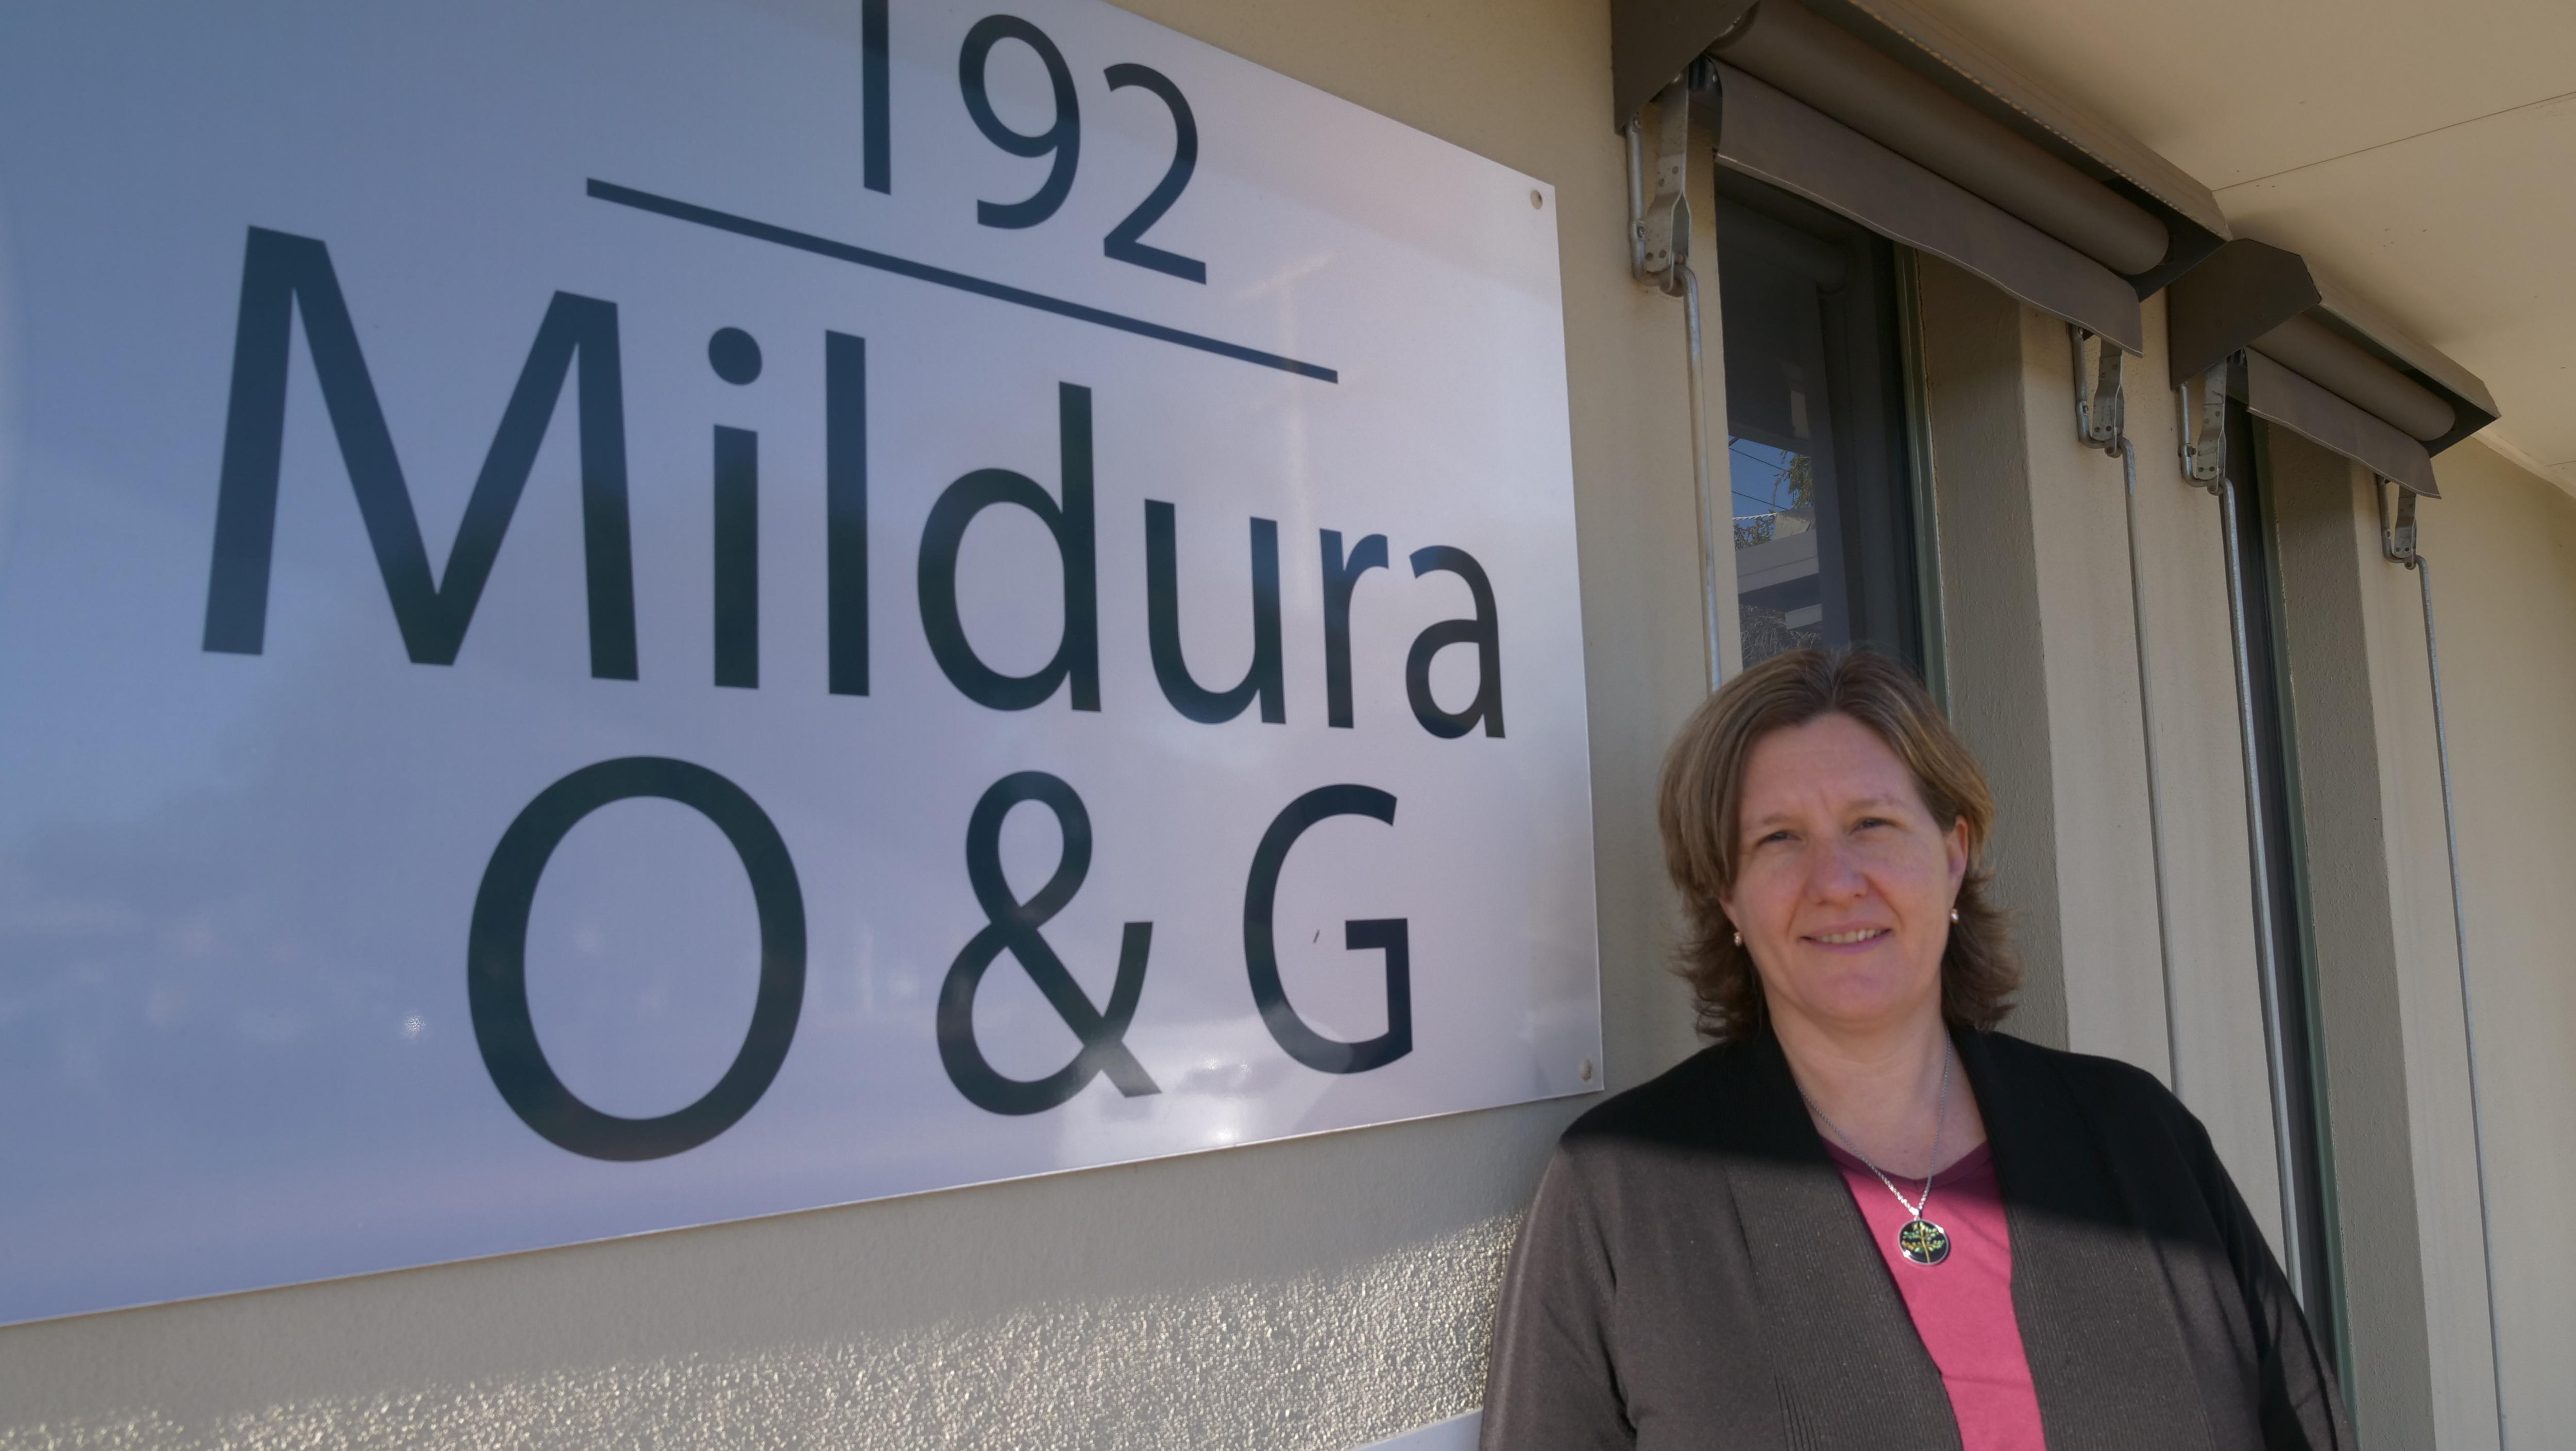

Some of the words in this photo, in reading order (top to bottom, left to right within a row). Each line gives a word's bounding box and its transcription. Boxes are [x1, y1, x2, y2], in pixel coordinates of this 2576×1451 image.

[861, 0, 1207, 285] 192
[201, 223, 1506, 741] Mildura
[466, 755, 807, 1163] O
[936, 770, 1160, 1117] &
[1242, 783, 1414, 1075] G
